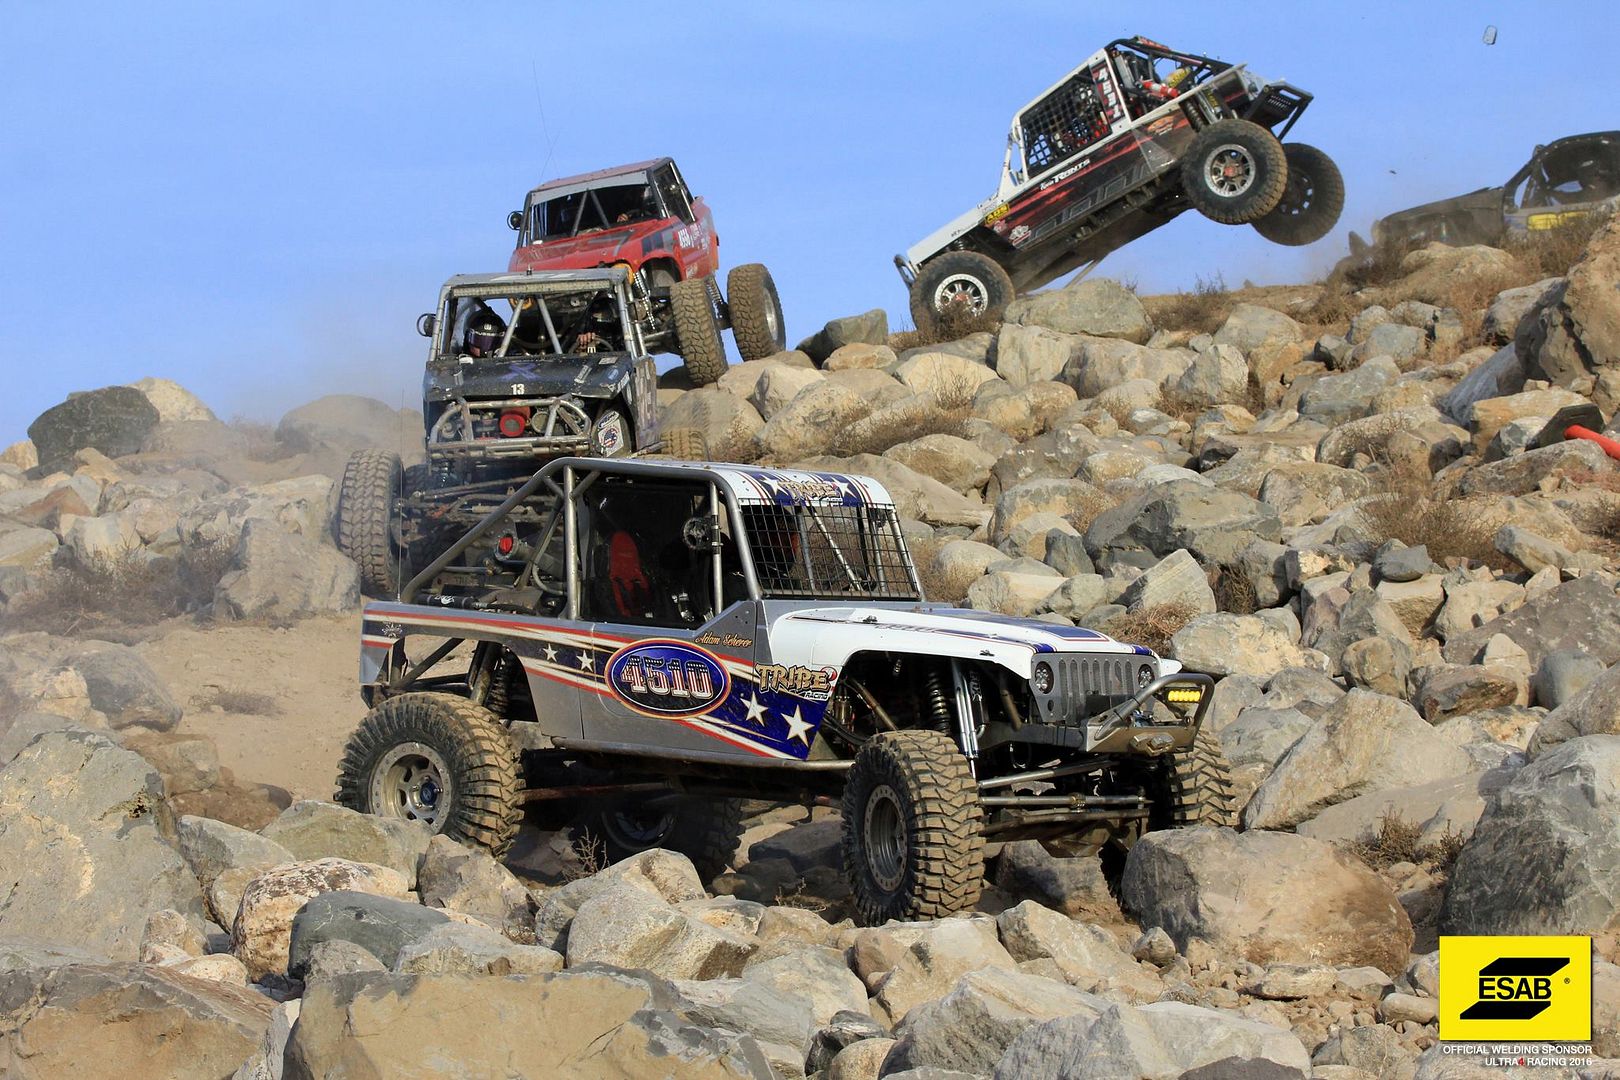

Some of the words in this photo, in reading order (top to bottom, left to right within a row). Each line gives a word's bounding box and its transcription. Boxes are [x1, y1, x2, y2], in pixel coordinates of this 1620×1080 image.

[510, 383, 525, 395] 13
[695, 631, 721, 645] Adam
[621, 655, 714, 699] 4510
[755, 663, 831, 693] TRIBE
[805, 692, 829, 700] RACING
